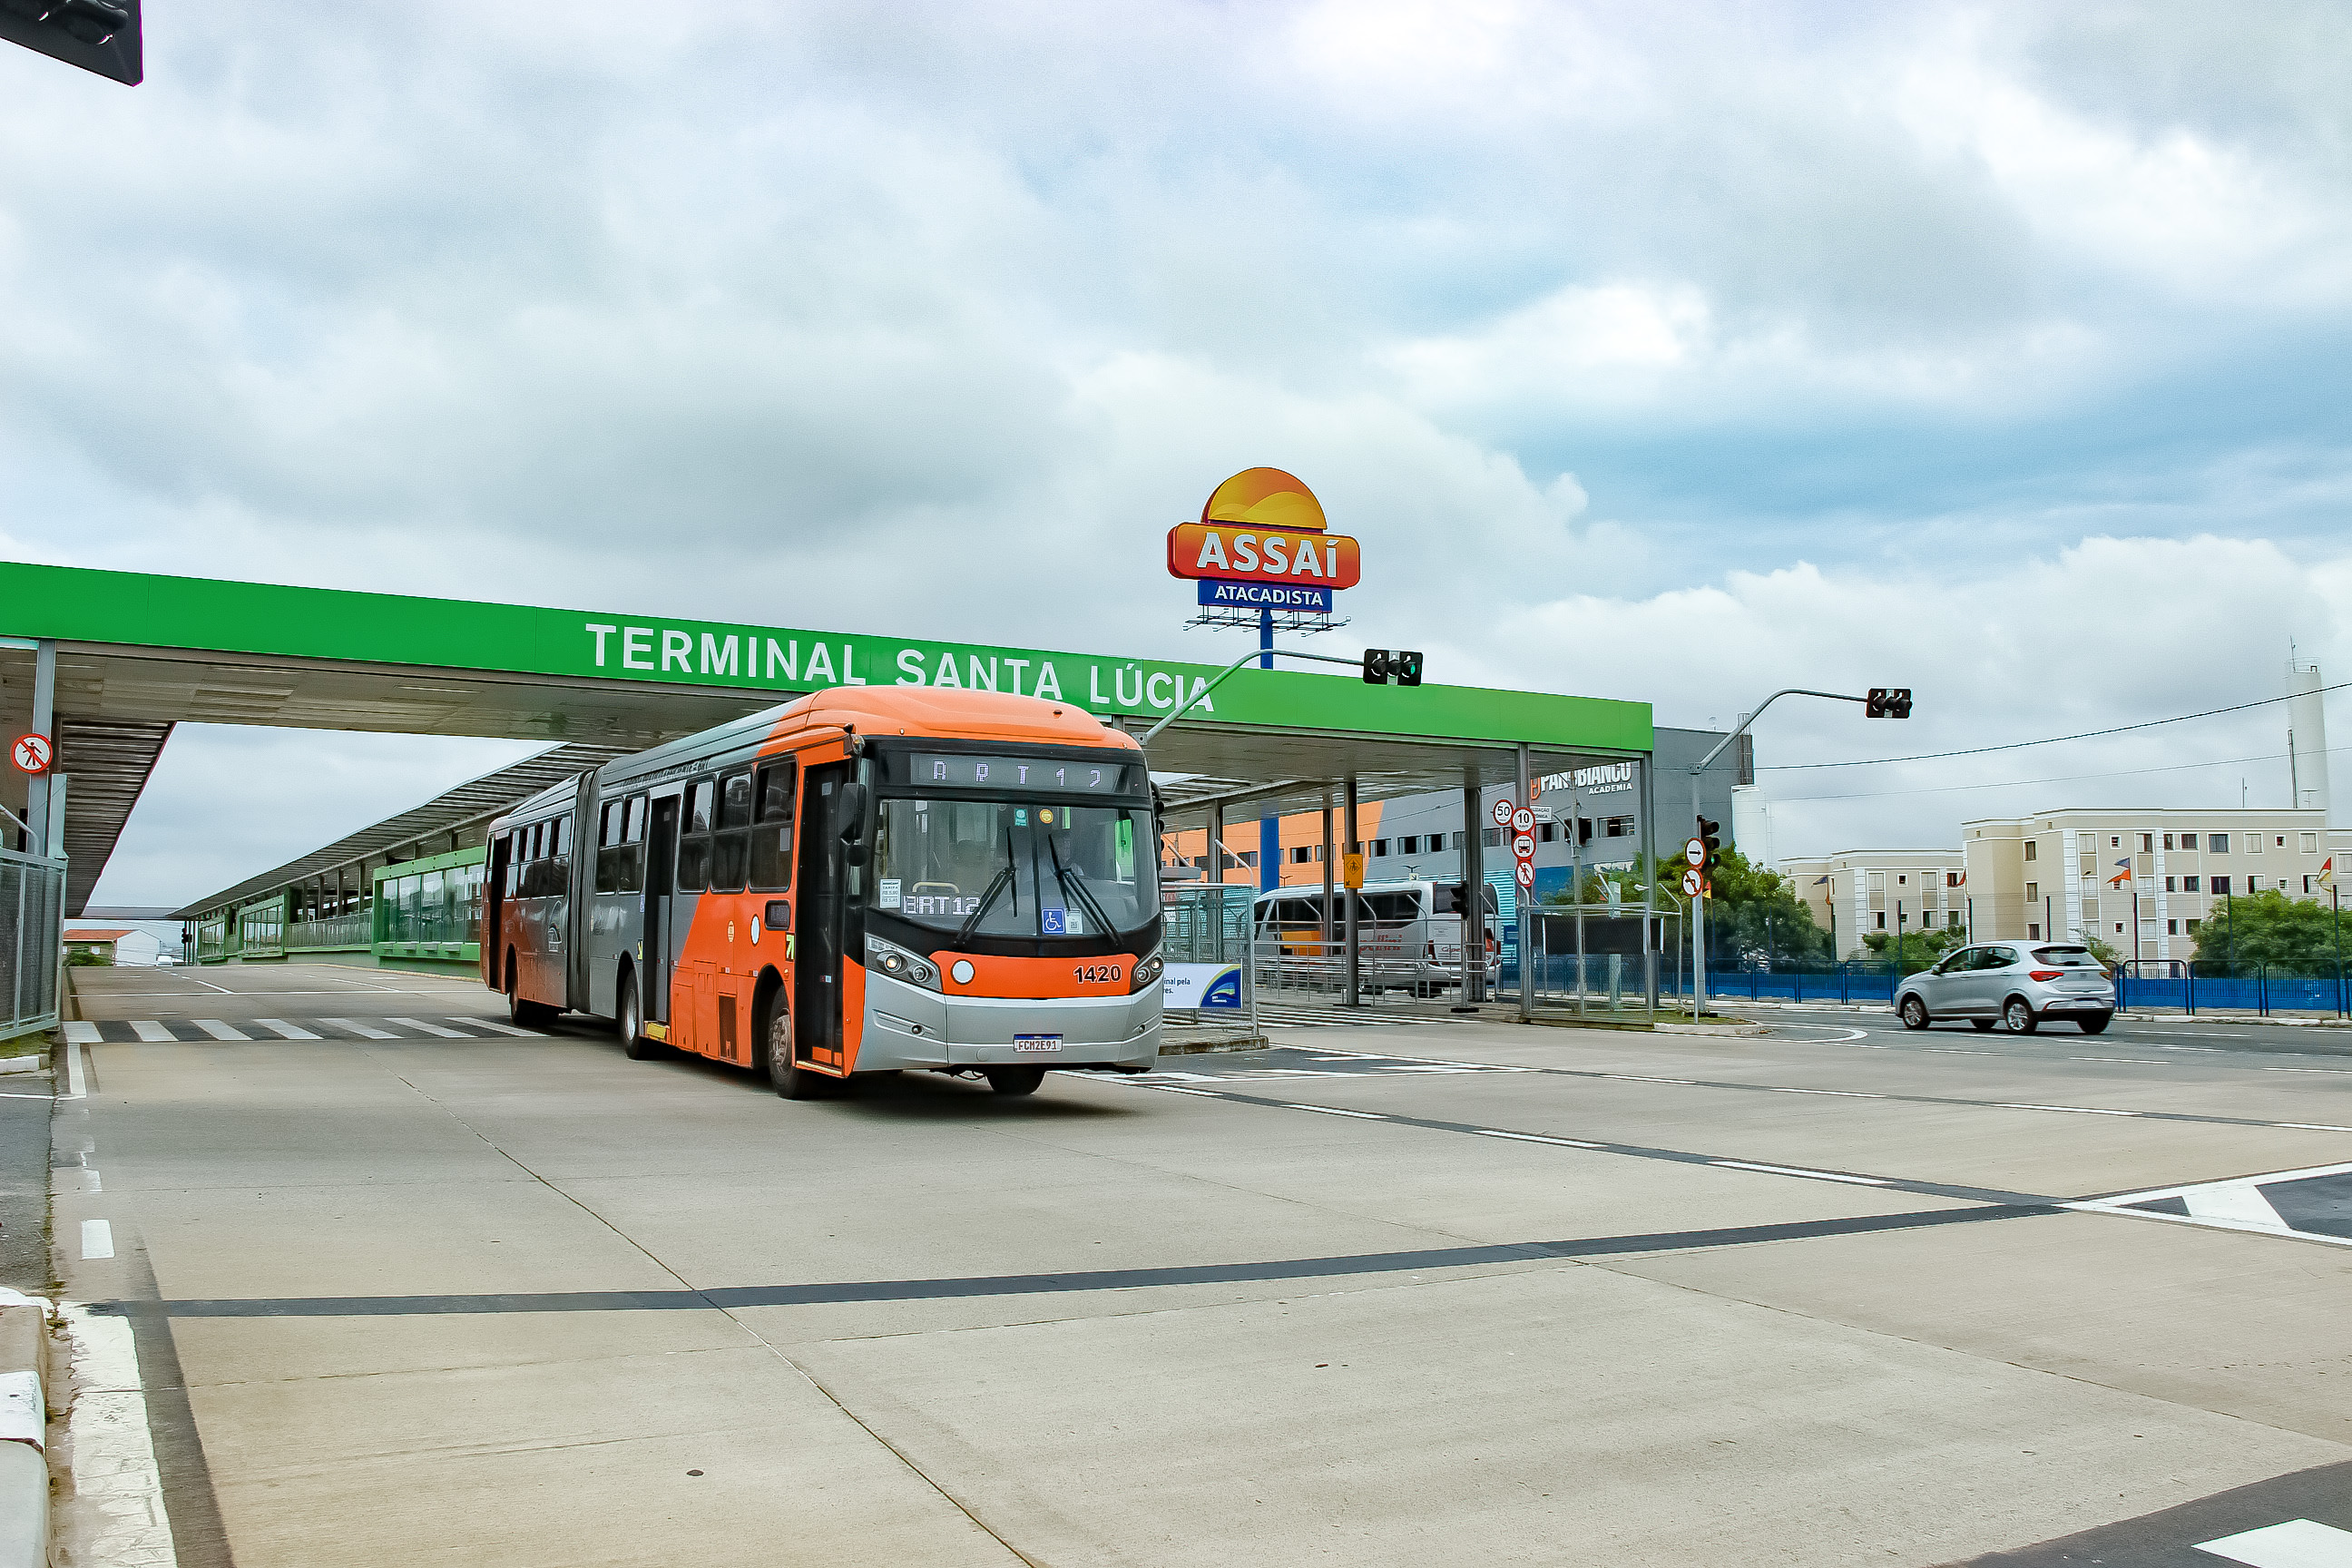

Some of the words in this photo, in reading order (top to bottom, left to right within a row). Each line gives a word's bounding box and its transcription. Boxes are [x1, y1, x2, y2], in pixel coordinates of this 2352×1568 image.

[1214, 585, 1324, 607] ATACADISTA
[585, 623, 867, 686] TERMINAL
[895, 648, 1063, 701] SANTA
[1090, 663, 1215, 712] LÚCIA
[1589, 782, 1633, 796] ACADEMIA
[1497, 806, 1511, 817] 50
[1517, 812, 1530, 824] 10
[1073, 964, 1122, 985] 1420
[1177, 977, 1191, 986] pela
[1018, 1040, 1057, 1051] FCM2E91
